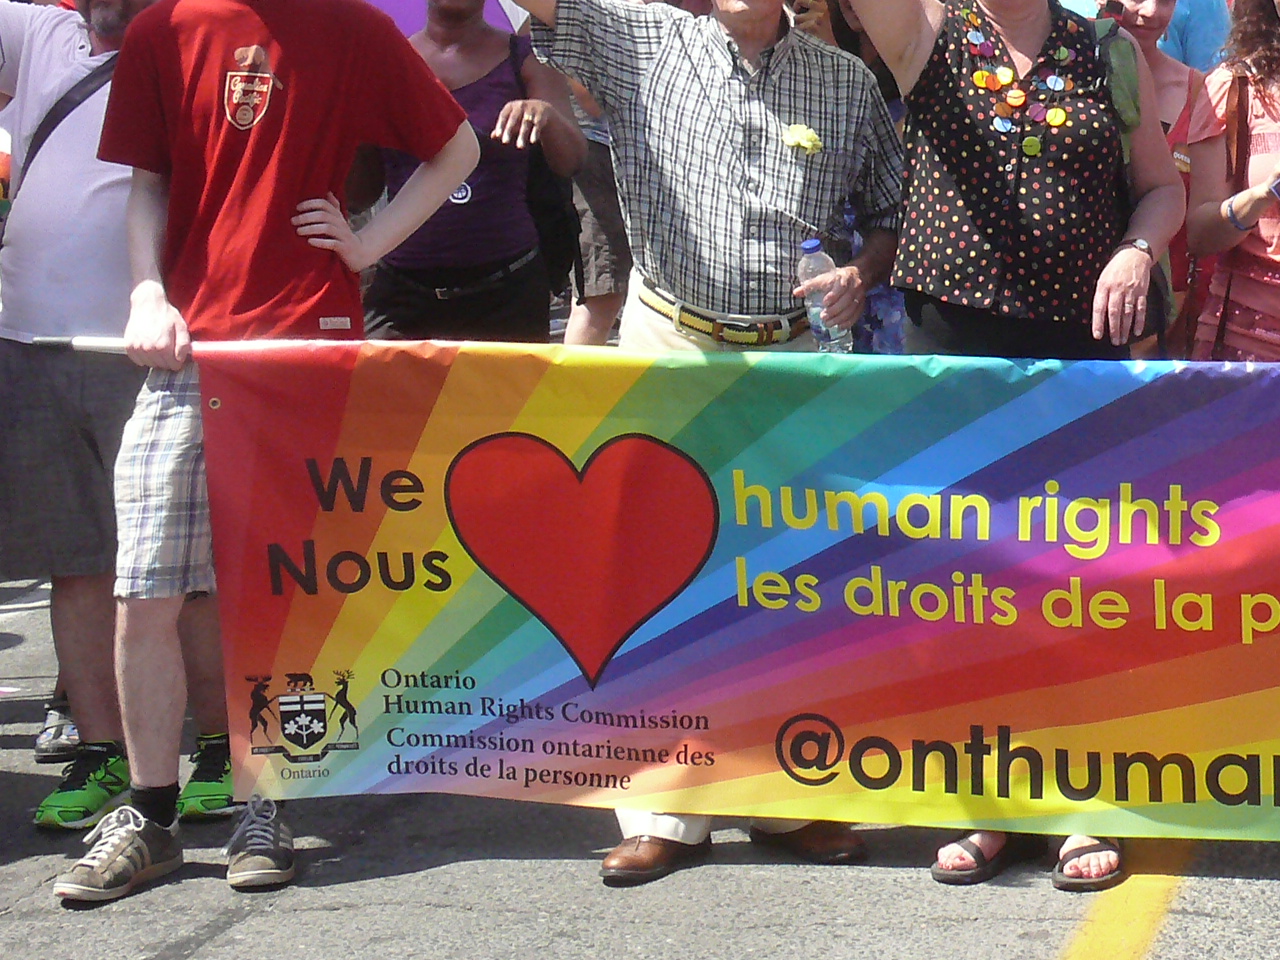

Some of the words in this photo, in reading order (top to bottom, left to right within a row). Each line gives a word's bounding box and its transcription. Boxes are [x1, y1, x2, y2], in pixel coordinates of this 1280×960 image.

[230, 76, 269, 93] Canadian
[304, 456, 425, 513] We
[733, 468, 992, 544] human
[1017, 480, 1222, 559] rights
[266, 539, 453, 597] Nous
[735, 557, 821, 613] les
[843, 569, 1019, 627] droits
[1041, 575, 1131, 632] de
[1154, 578, 1215, 633] la
[380, 668, 476, 691] Ontario
[382, 694, 473, 717] Human
[480, 696, 555, 723] Rights
[561, 702, 711, 731] Commission
[386, 726, 536, 755] Commission
[542, 737, 670, 764] ontarienne
[675, 743, 715, 767] des
[280, 765, 330, 780] Ontario
[387, 754, 459, 777] droits
[464, 756, 491, 779] de
[498, 759, 518, 782] la
[524, 765, 632, 791] personne
